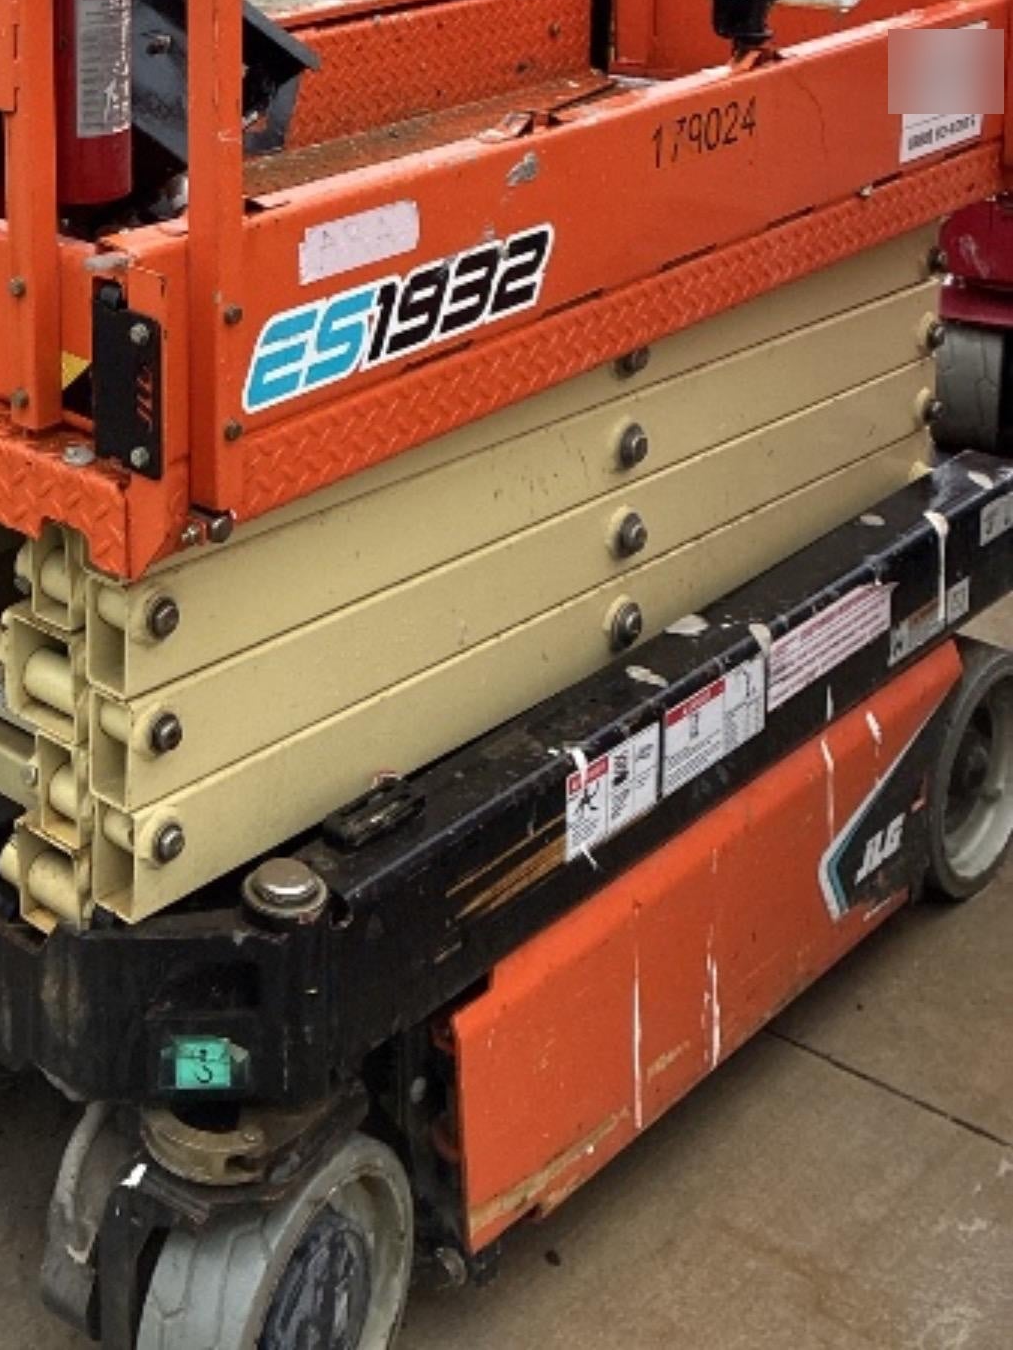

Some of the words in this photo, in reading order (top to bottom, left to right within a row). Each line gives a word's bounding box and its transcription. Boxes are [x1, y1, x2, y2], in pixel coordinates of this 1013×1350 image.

[652, 95, 756, 168] 179024
[243, 223, 554, 414] ES1932
[854, 812, 906, 887] JLG
